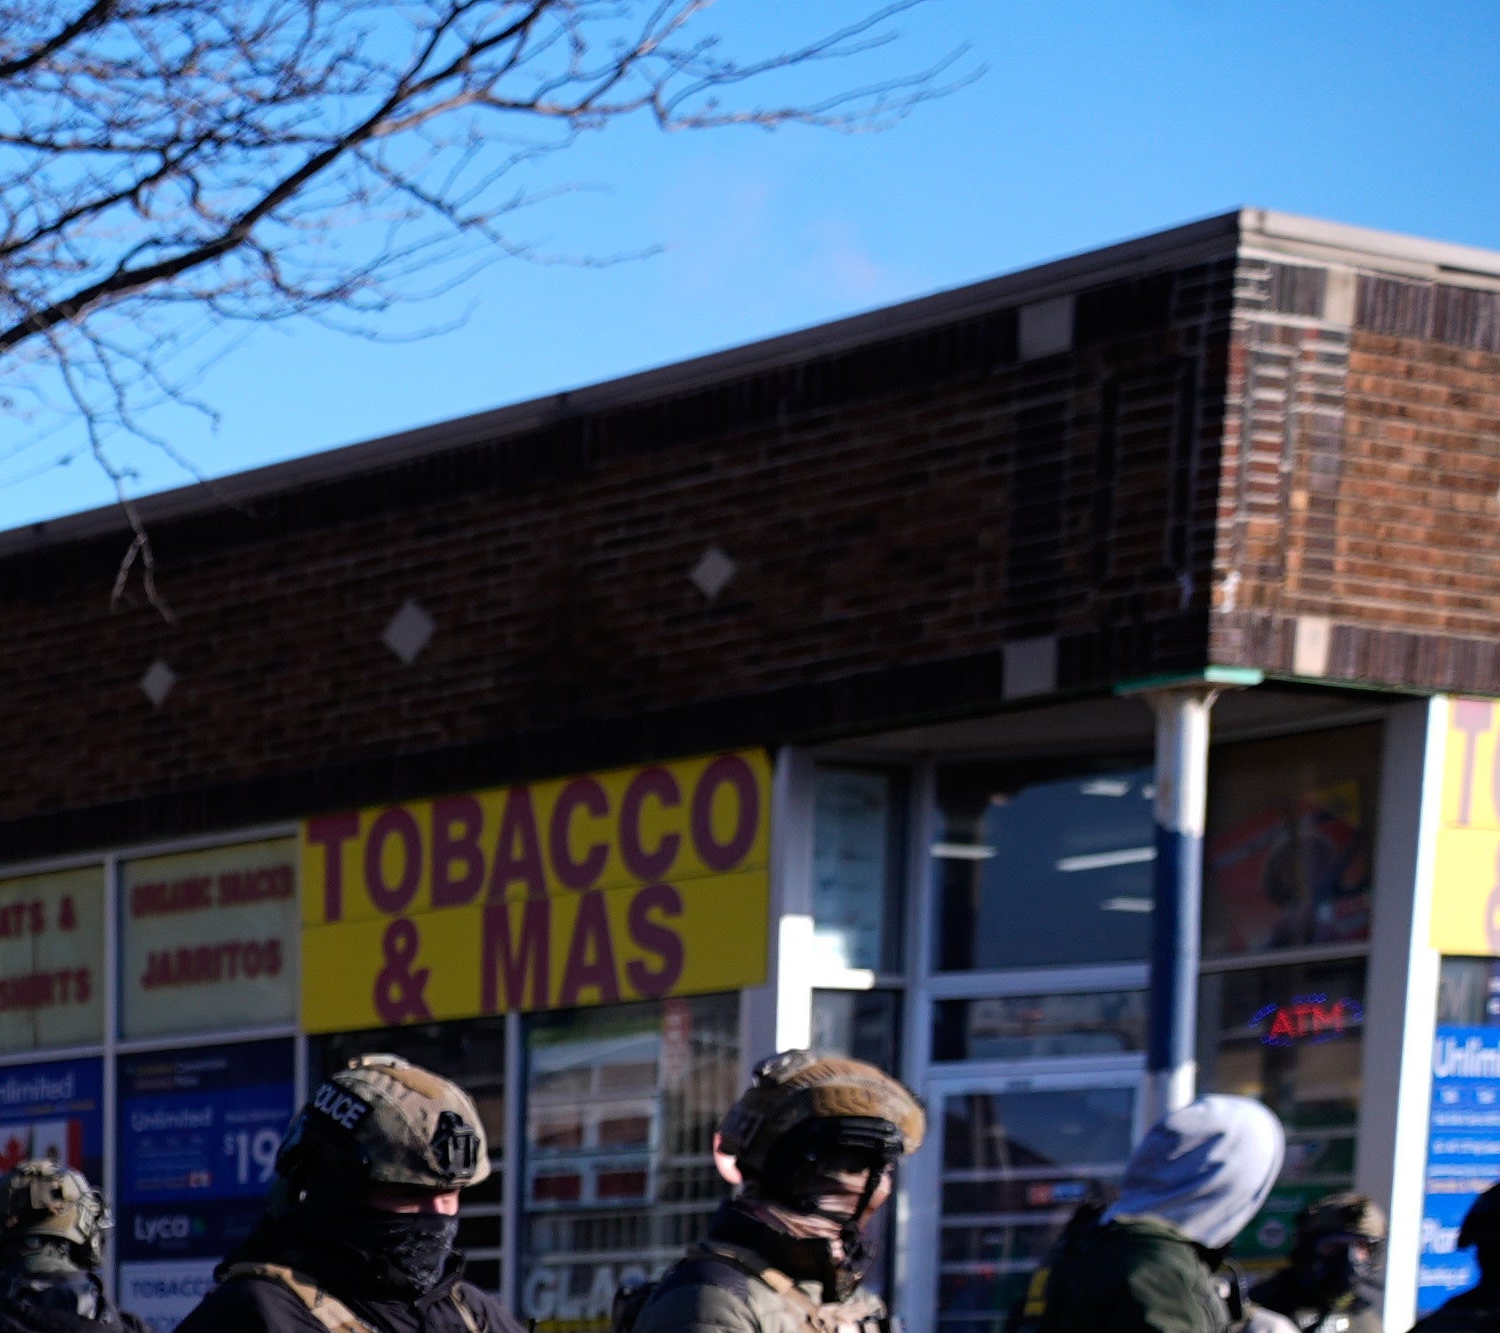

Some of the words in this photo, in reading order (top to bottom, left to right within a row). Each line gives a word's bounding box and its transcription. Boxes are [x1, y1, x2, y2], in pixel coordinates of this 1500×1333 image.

[307, 752, 760, 922] TOBACCO
[140, 939, 282, 990] JARRITOS
[373, 918, 434, 1027] &
[481, 882, 686, 1014] MAS
[1269, 1000, 1345, 1039] ATM
